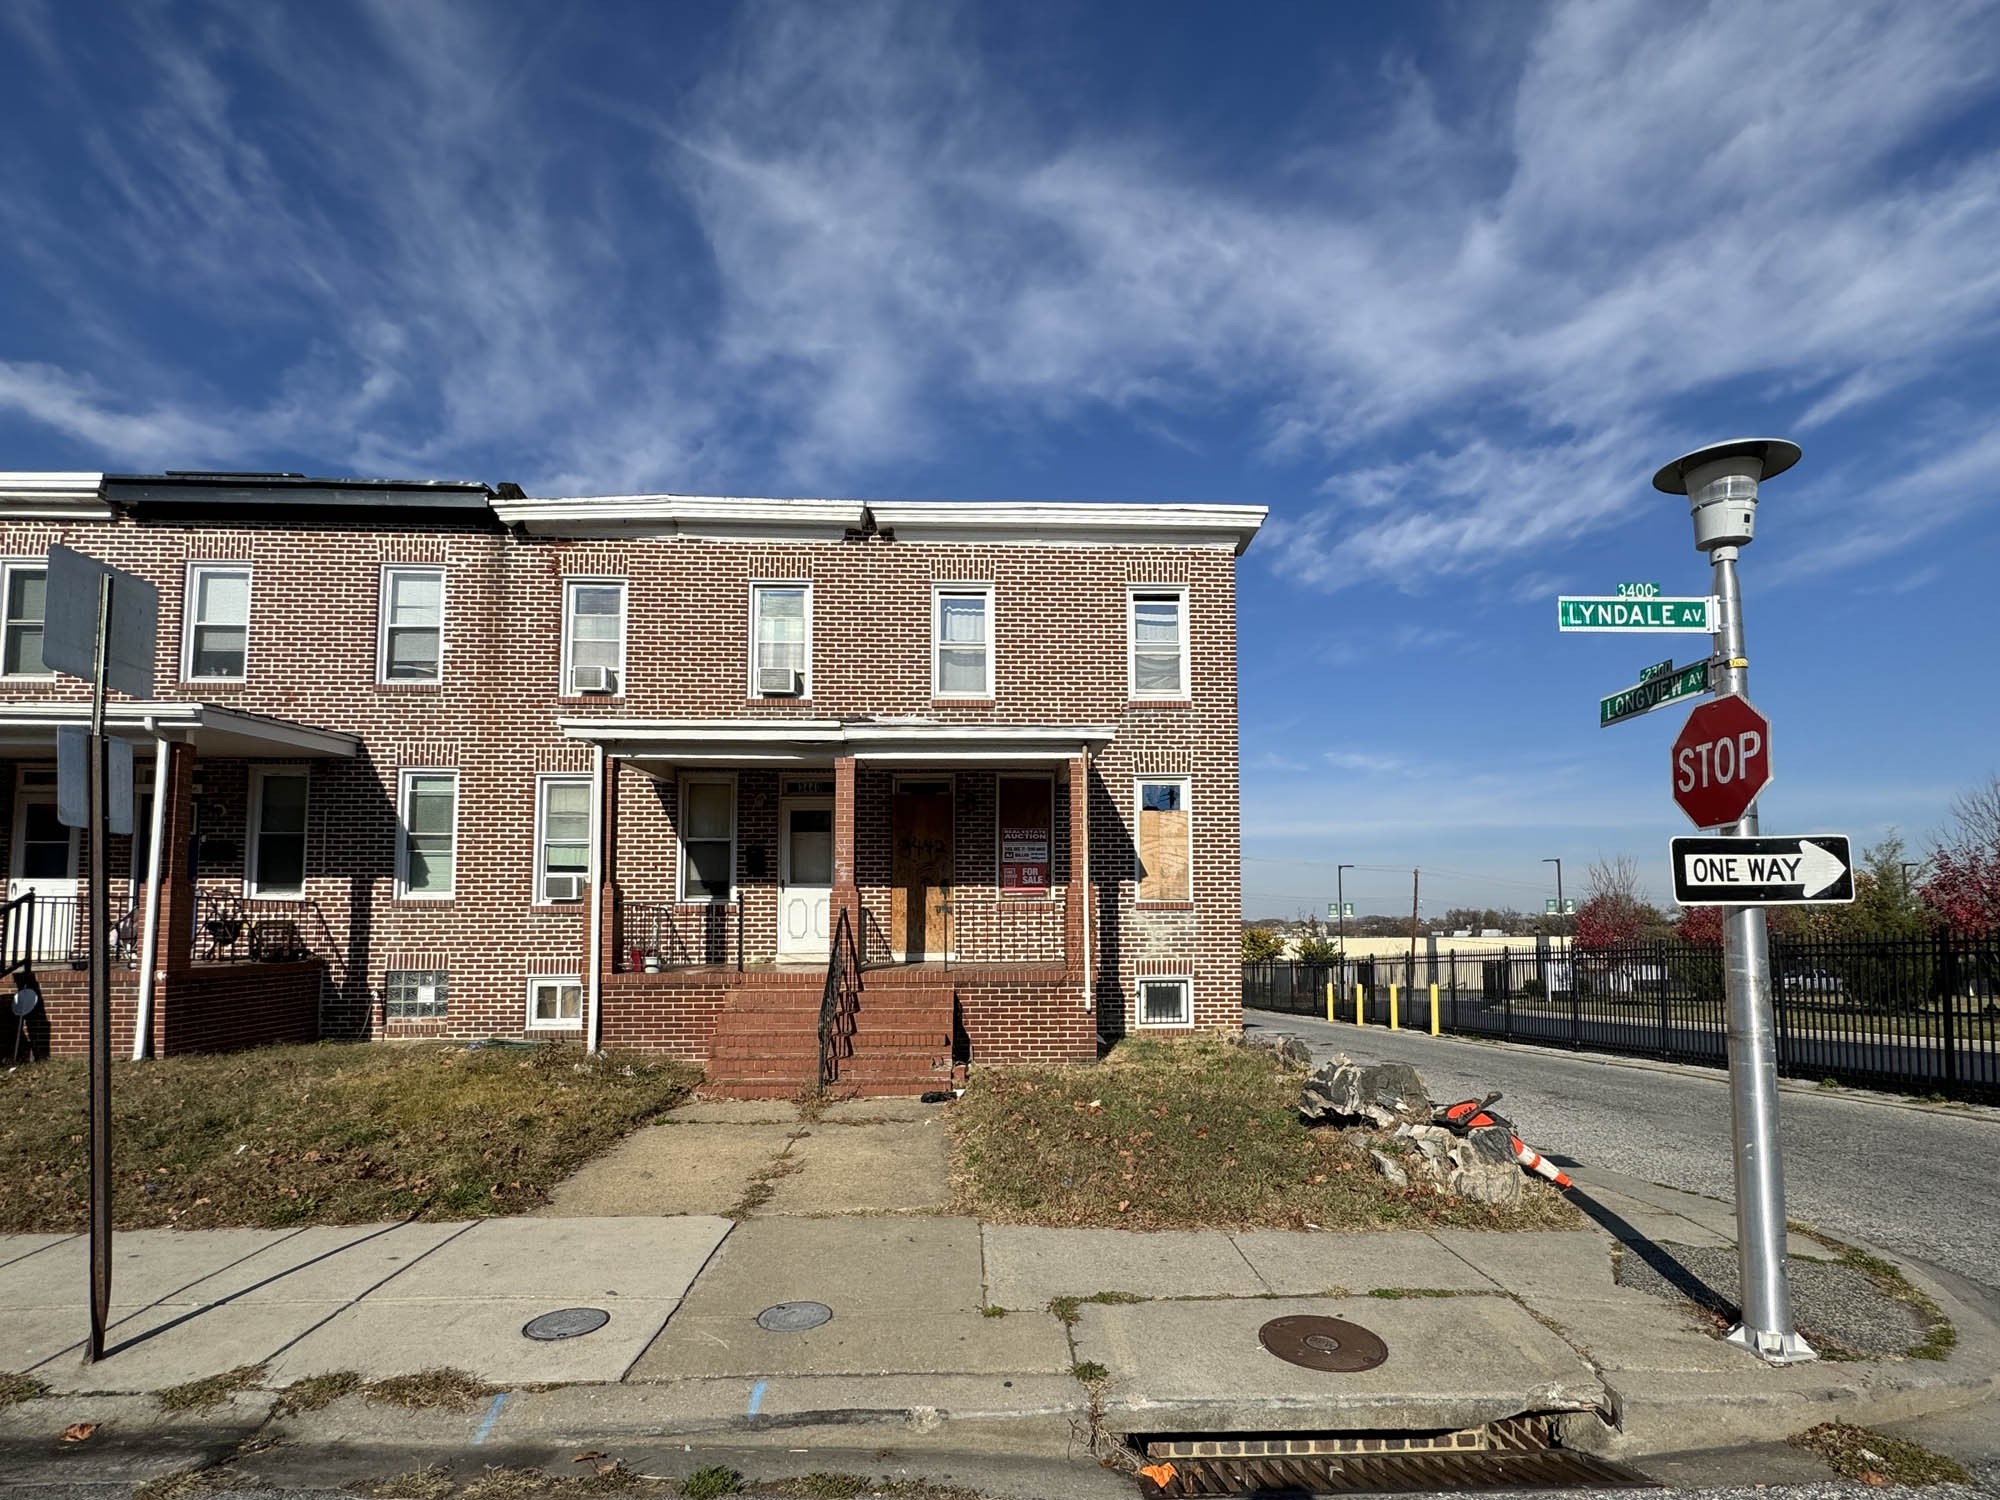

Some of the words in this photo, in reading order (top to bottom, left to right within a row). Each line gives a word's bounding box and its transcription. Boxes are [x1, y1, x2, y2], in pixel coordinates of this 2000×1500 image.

[1618, 583, 1653, 597] 3400
[1569, 604, 1675, 625] LYNDALE
[1607, 675, 1683, 719] LONGVIEW
[1678, 730, 1761, 793] STOP
[1022, 867, 1038, 876] FOR
[1022, 875, 1043, 884] SALE
[1693, 858, 1739, 882] ONE
[1747, 857, 1802, 882] WAY
